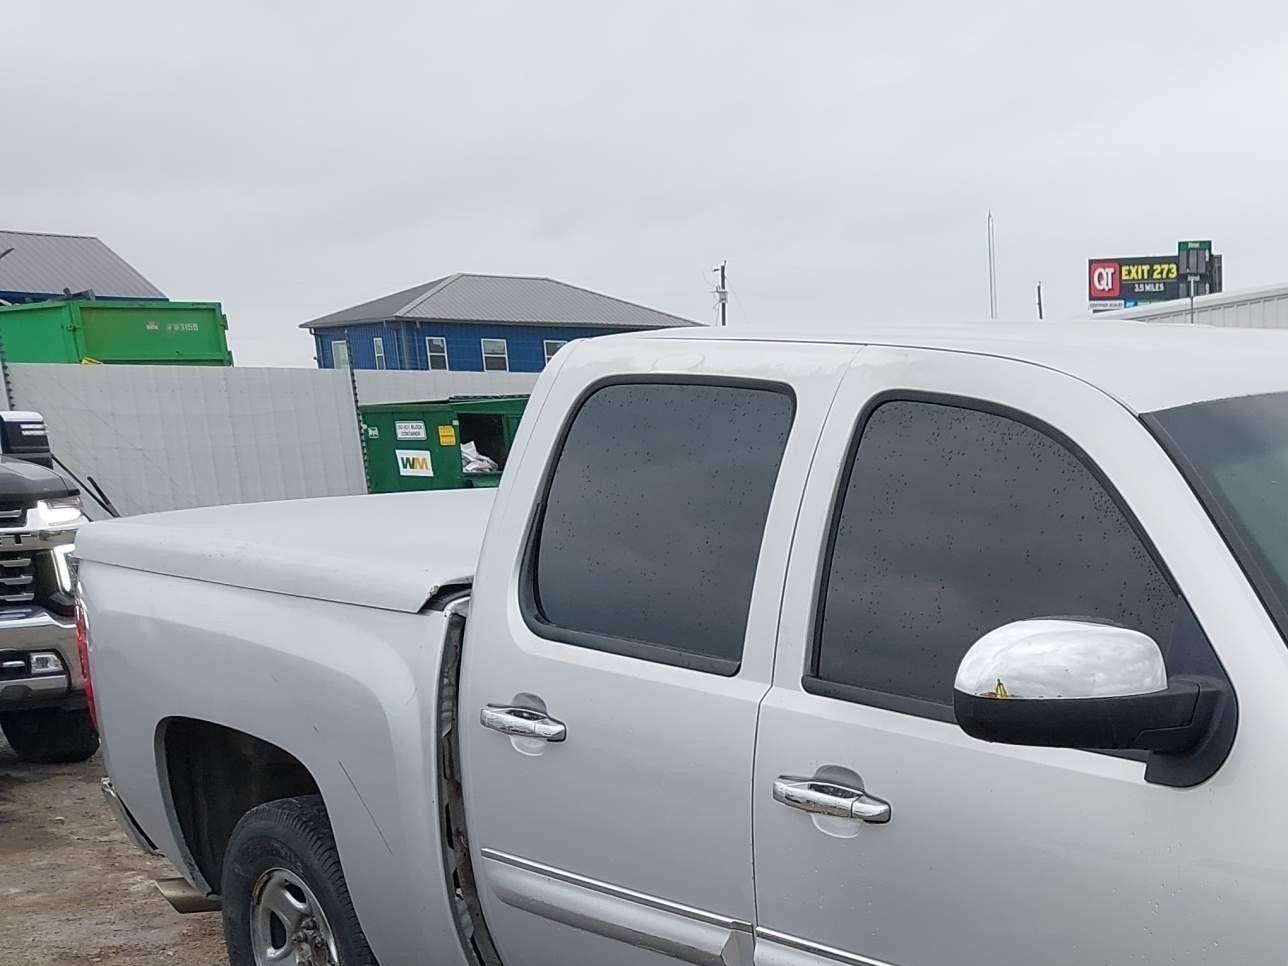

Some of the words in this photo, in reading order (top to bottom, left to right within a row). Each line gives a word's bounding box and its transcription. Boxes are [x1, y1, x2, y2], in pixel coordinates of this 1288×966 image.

[1121, 264, 1150, 280] EXIT
[1152, 263, 1177, 279] 273
[1094, 267, 1115, 292] QT
[1145, 282, 1165, 292] MILES
[401, 457, 428, 470] WM
